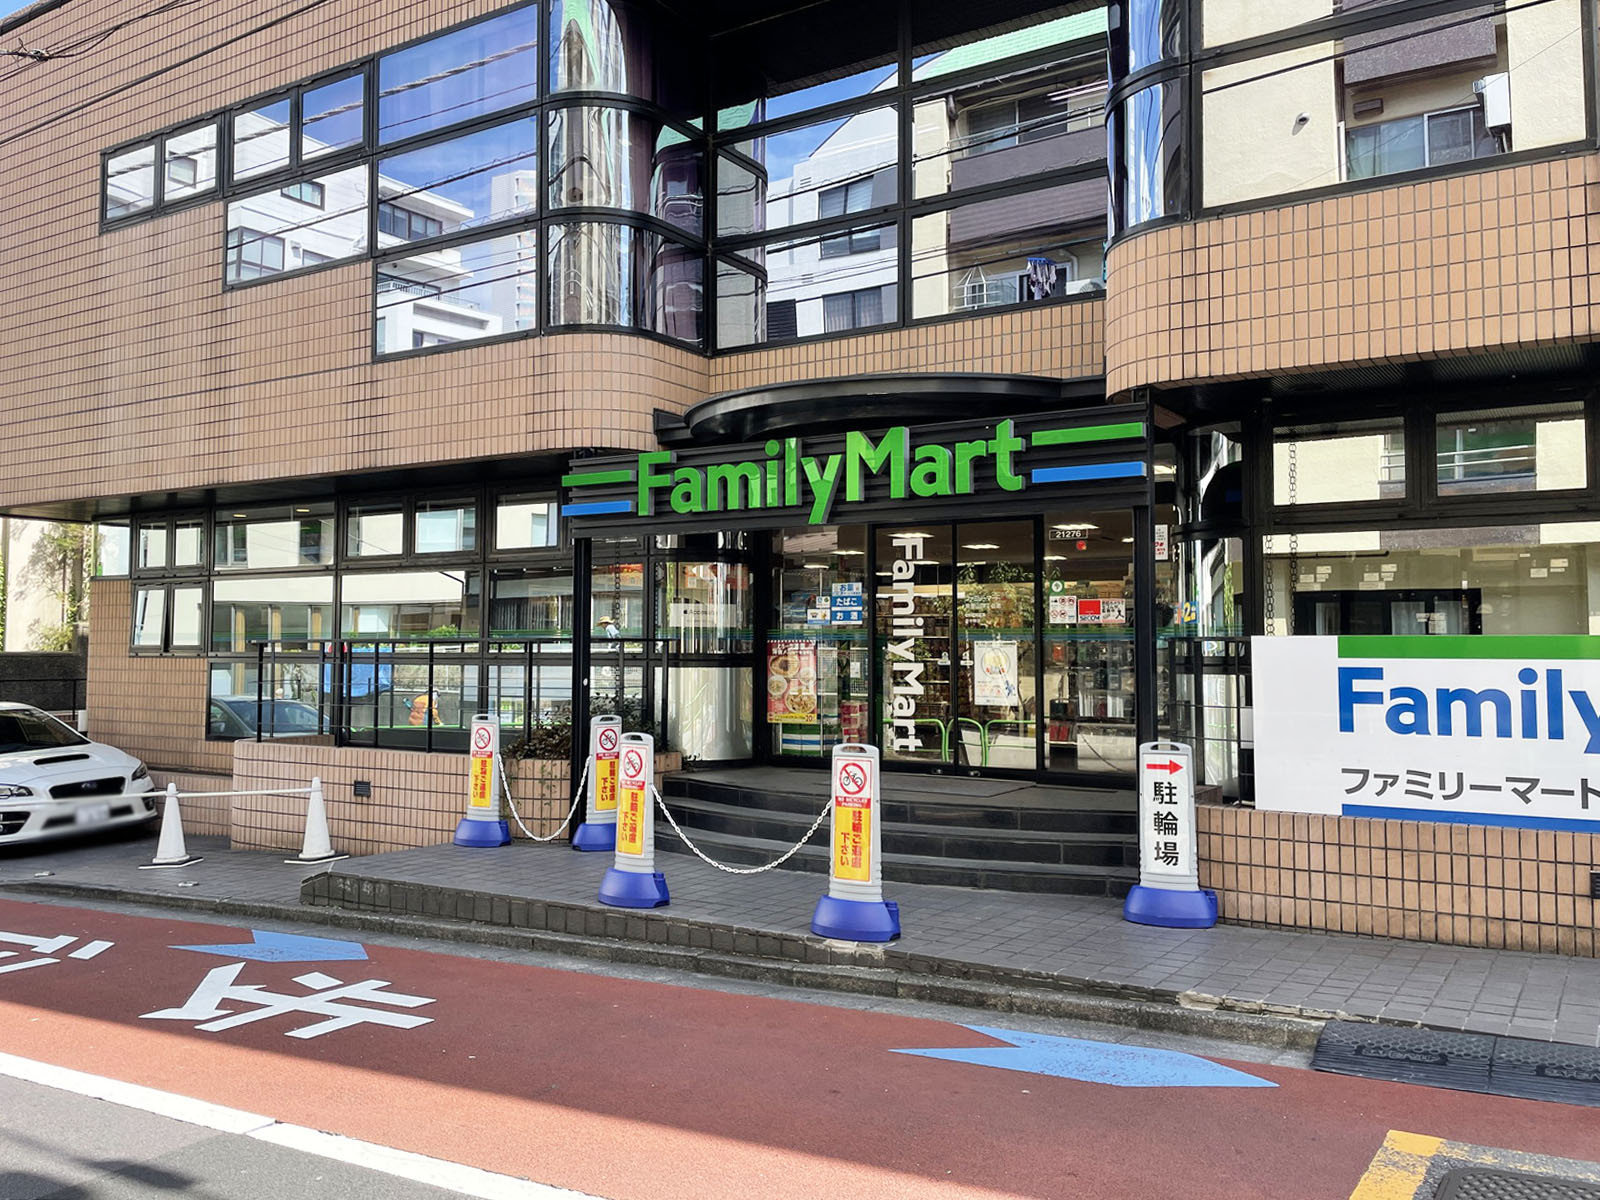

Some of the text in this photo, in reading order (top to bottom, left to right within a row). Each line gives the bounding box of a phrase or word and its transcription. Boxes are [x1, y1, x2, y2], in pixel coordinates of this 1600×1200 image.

[638, 418, 1025, 525] FamilyMart
[1056, 530, 1081, 538] 21276
[836, 597, 858, 607] たばこ
[887, 538, 924, 752] FamilyMart
[1338, 667, 1600, 754] Family
[1341, 767, 1600, 809] ファミリーマート
[840, 832, 850, 866] 下さい
[1153, 781, 1179, 866] 駐輪場
